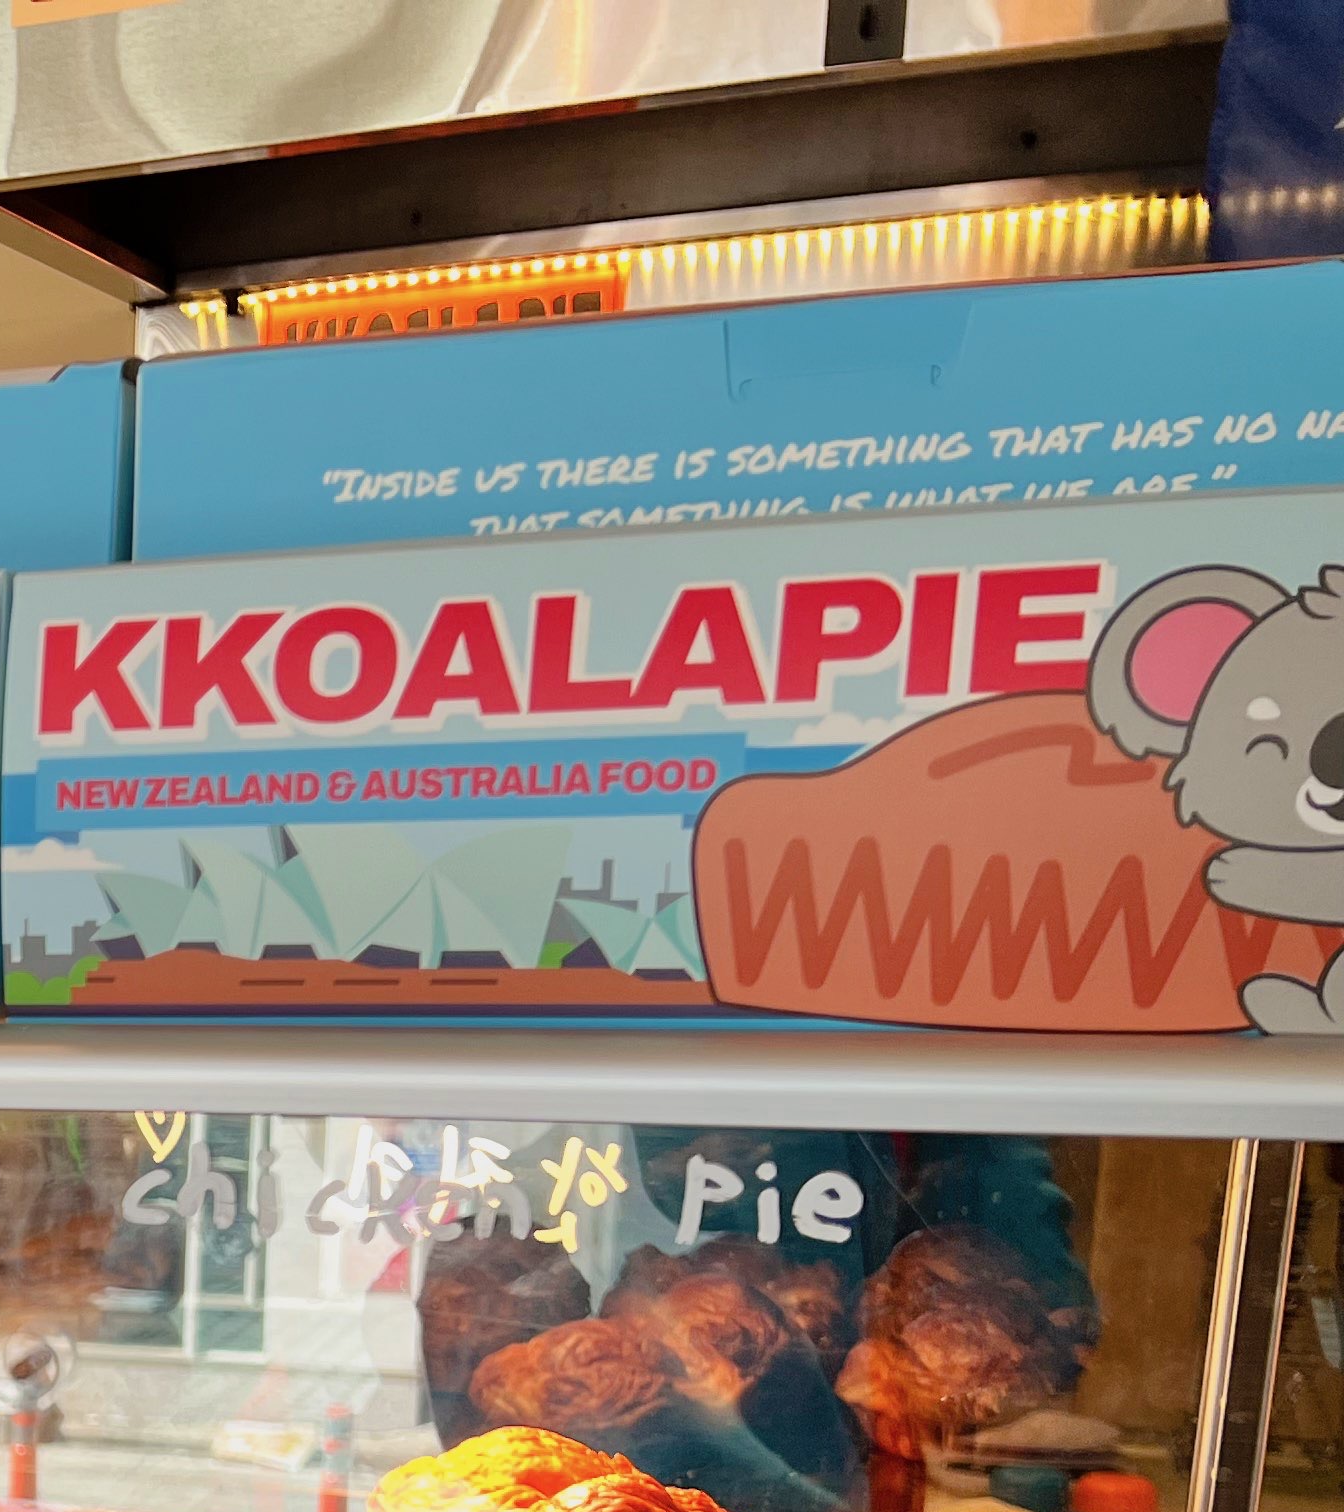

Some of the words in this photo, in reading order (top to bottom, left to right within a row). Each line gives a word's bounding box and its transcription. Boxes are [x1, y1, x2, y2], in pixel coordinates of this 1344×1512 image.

[474, 461, 528, 494] US
[536, 452, 660, 490] THERE
[674, 447, 717, 480] IS
[726, 431, 973, 477] SOMETHING
[989, 421, 1106, 458] THAT
[1111, 414, 1205, 452] HAS
[1213, 411, 1279, 444] NO
[468, 511, 572, 537] THAT
[829, 490, 872, 514] IS
[884, 481, 1015, 511] WHAT
[38, 564, 1101, 735] KKOALAPIE
[326, 769, 357, 802] &
[359, 762, 593, 803] AUSTRALIA
[596, 757, 718, 796] FOOD
